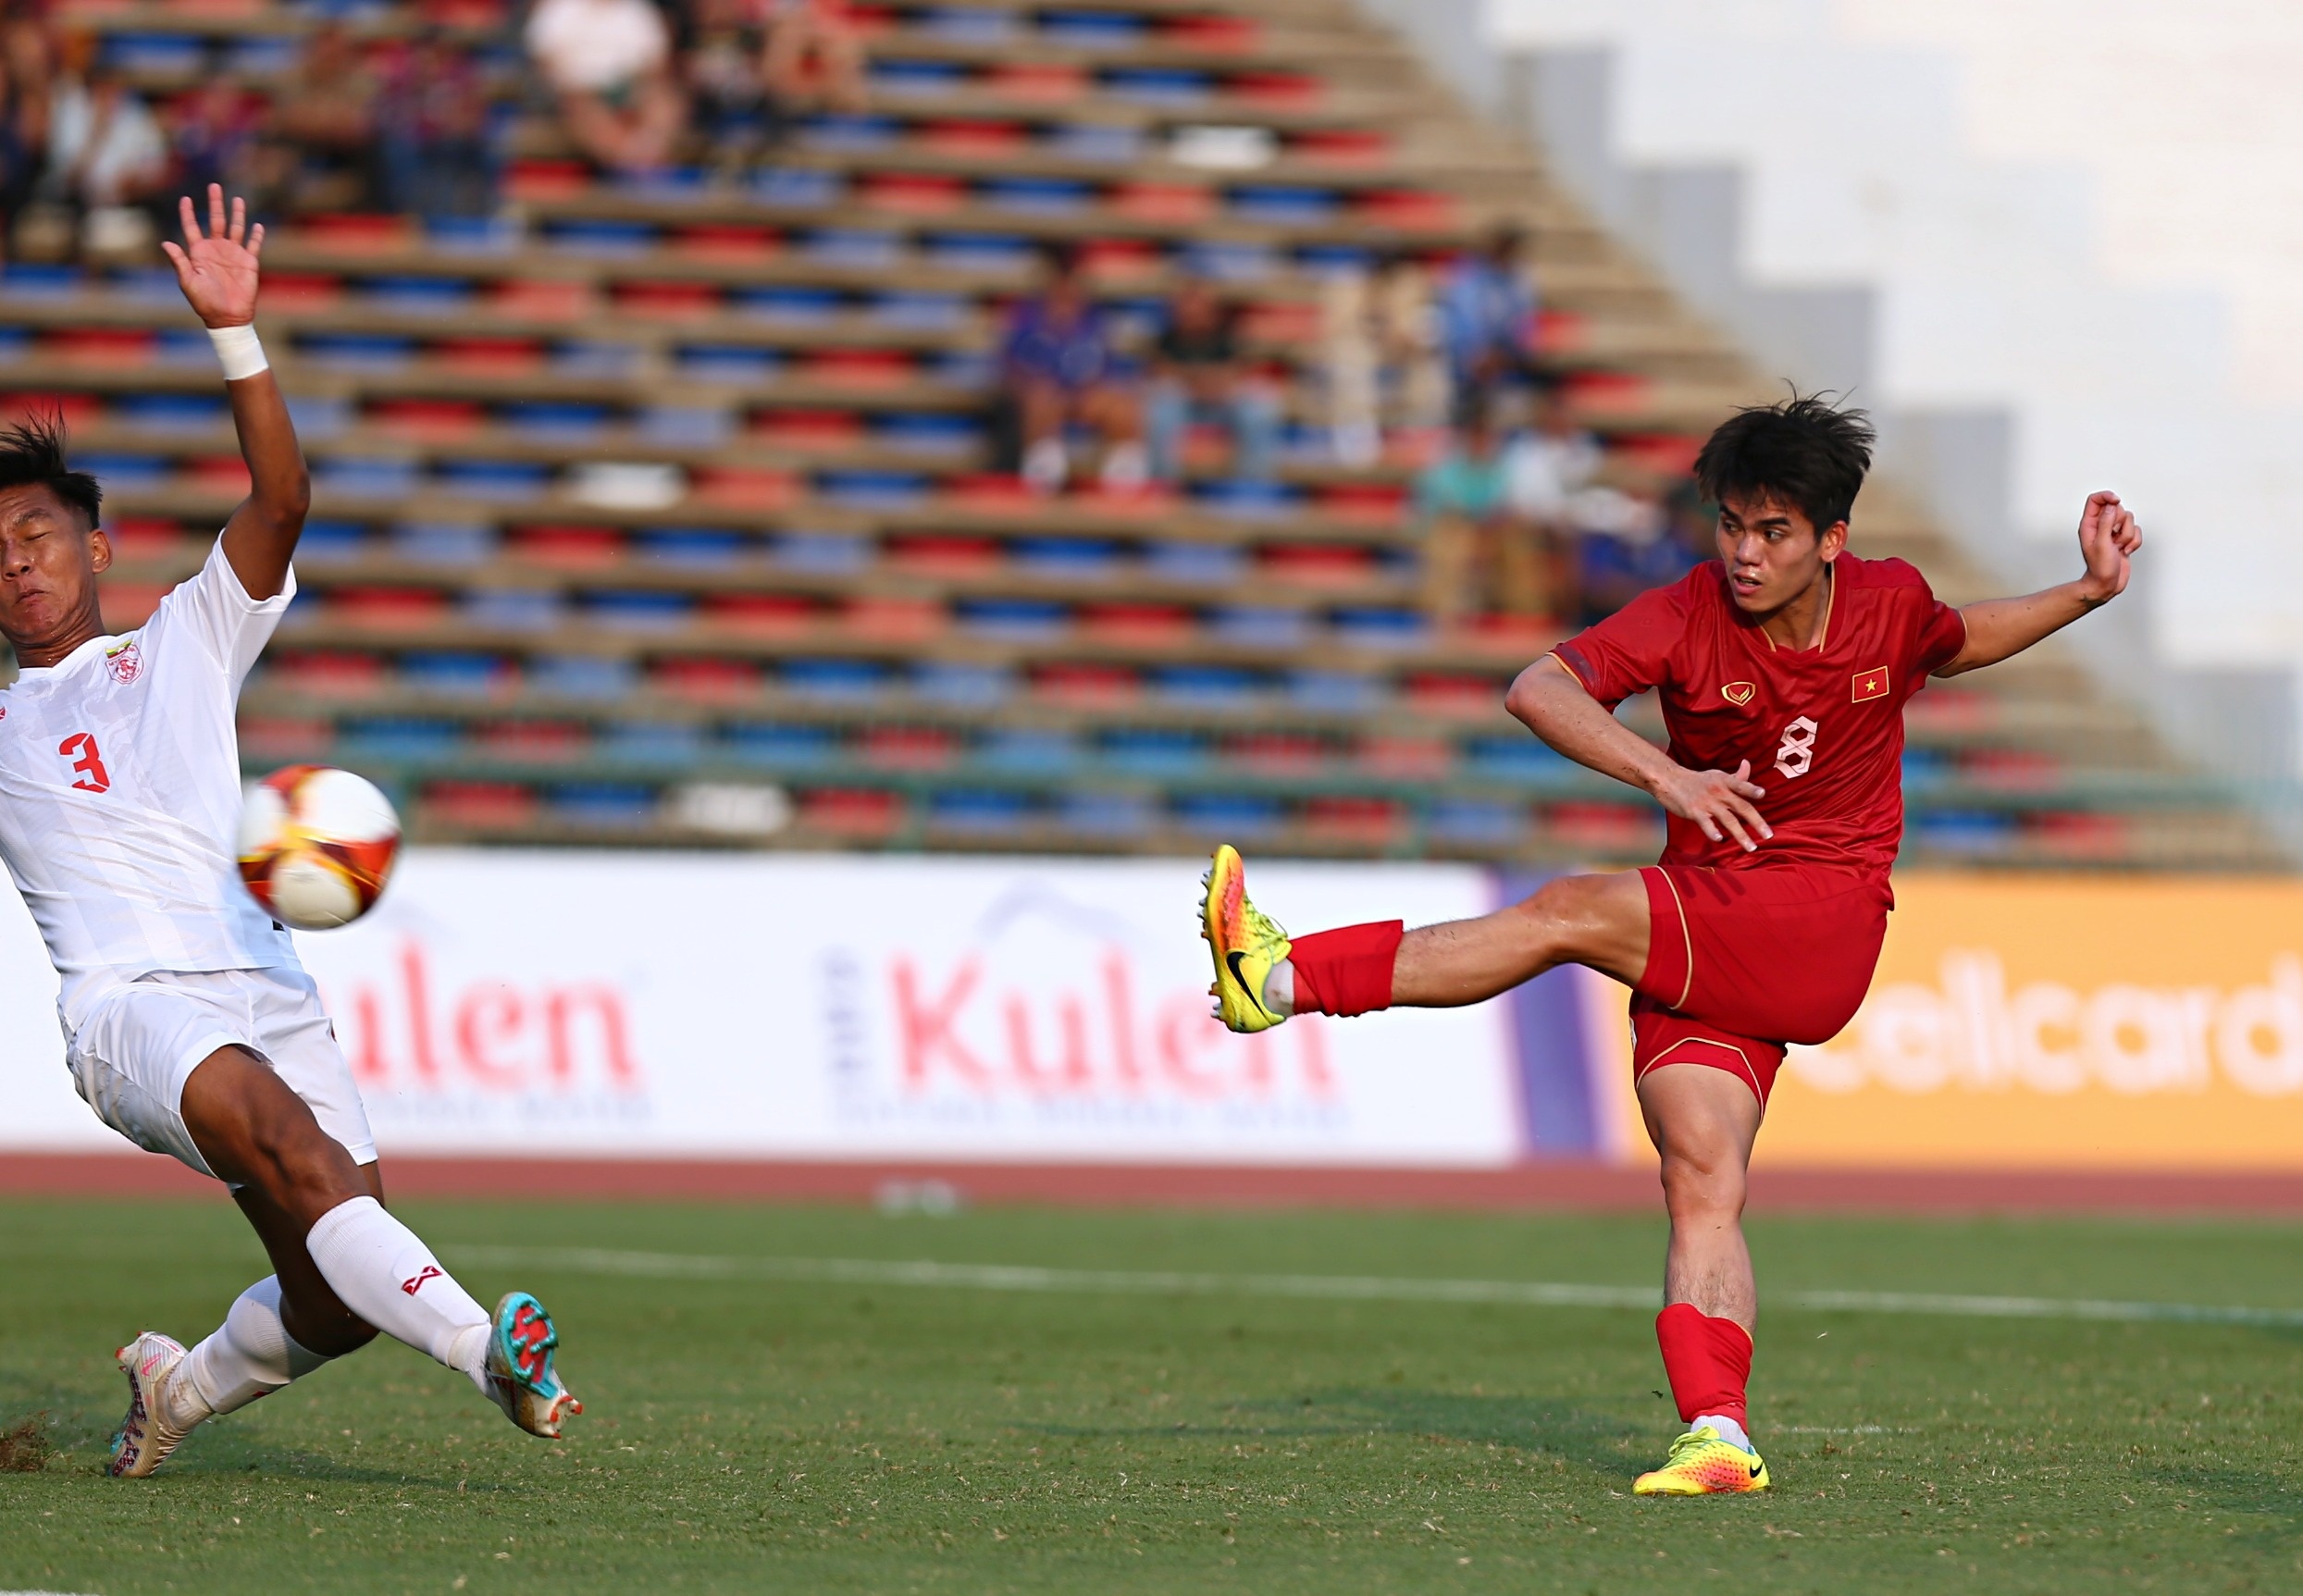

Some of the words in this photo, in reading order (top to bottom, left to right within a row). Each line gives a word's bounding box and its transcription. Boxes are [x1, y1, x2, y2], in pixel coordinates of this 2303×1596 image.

[59, 732, 110, 794] 3
[1773, 715, 1818, 779] 8
[322, 938, 640, 1090] ulen
